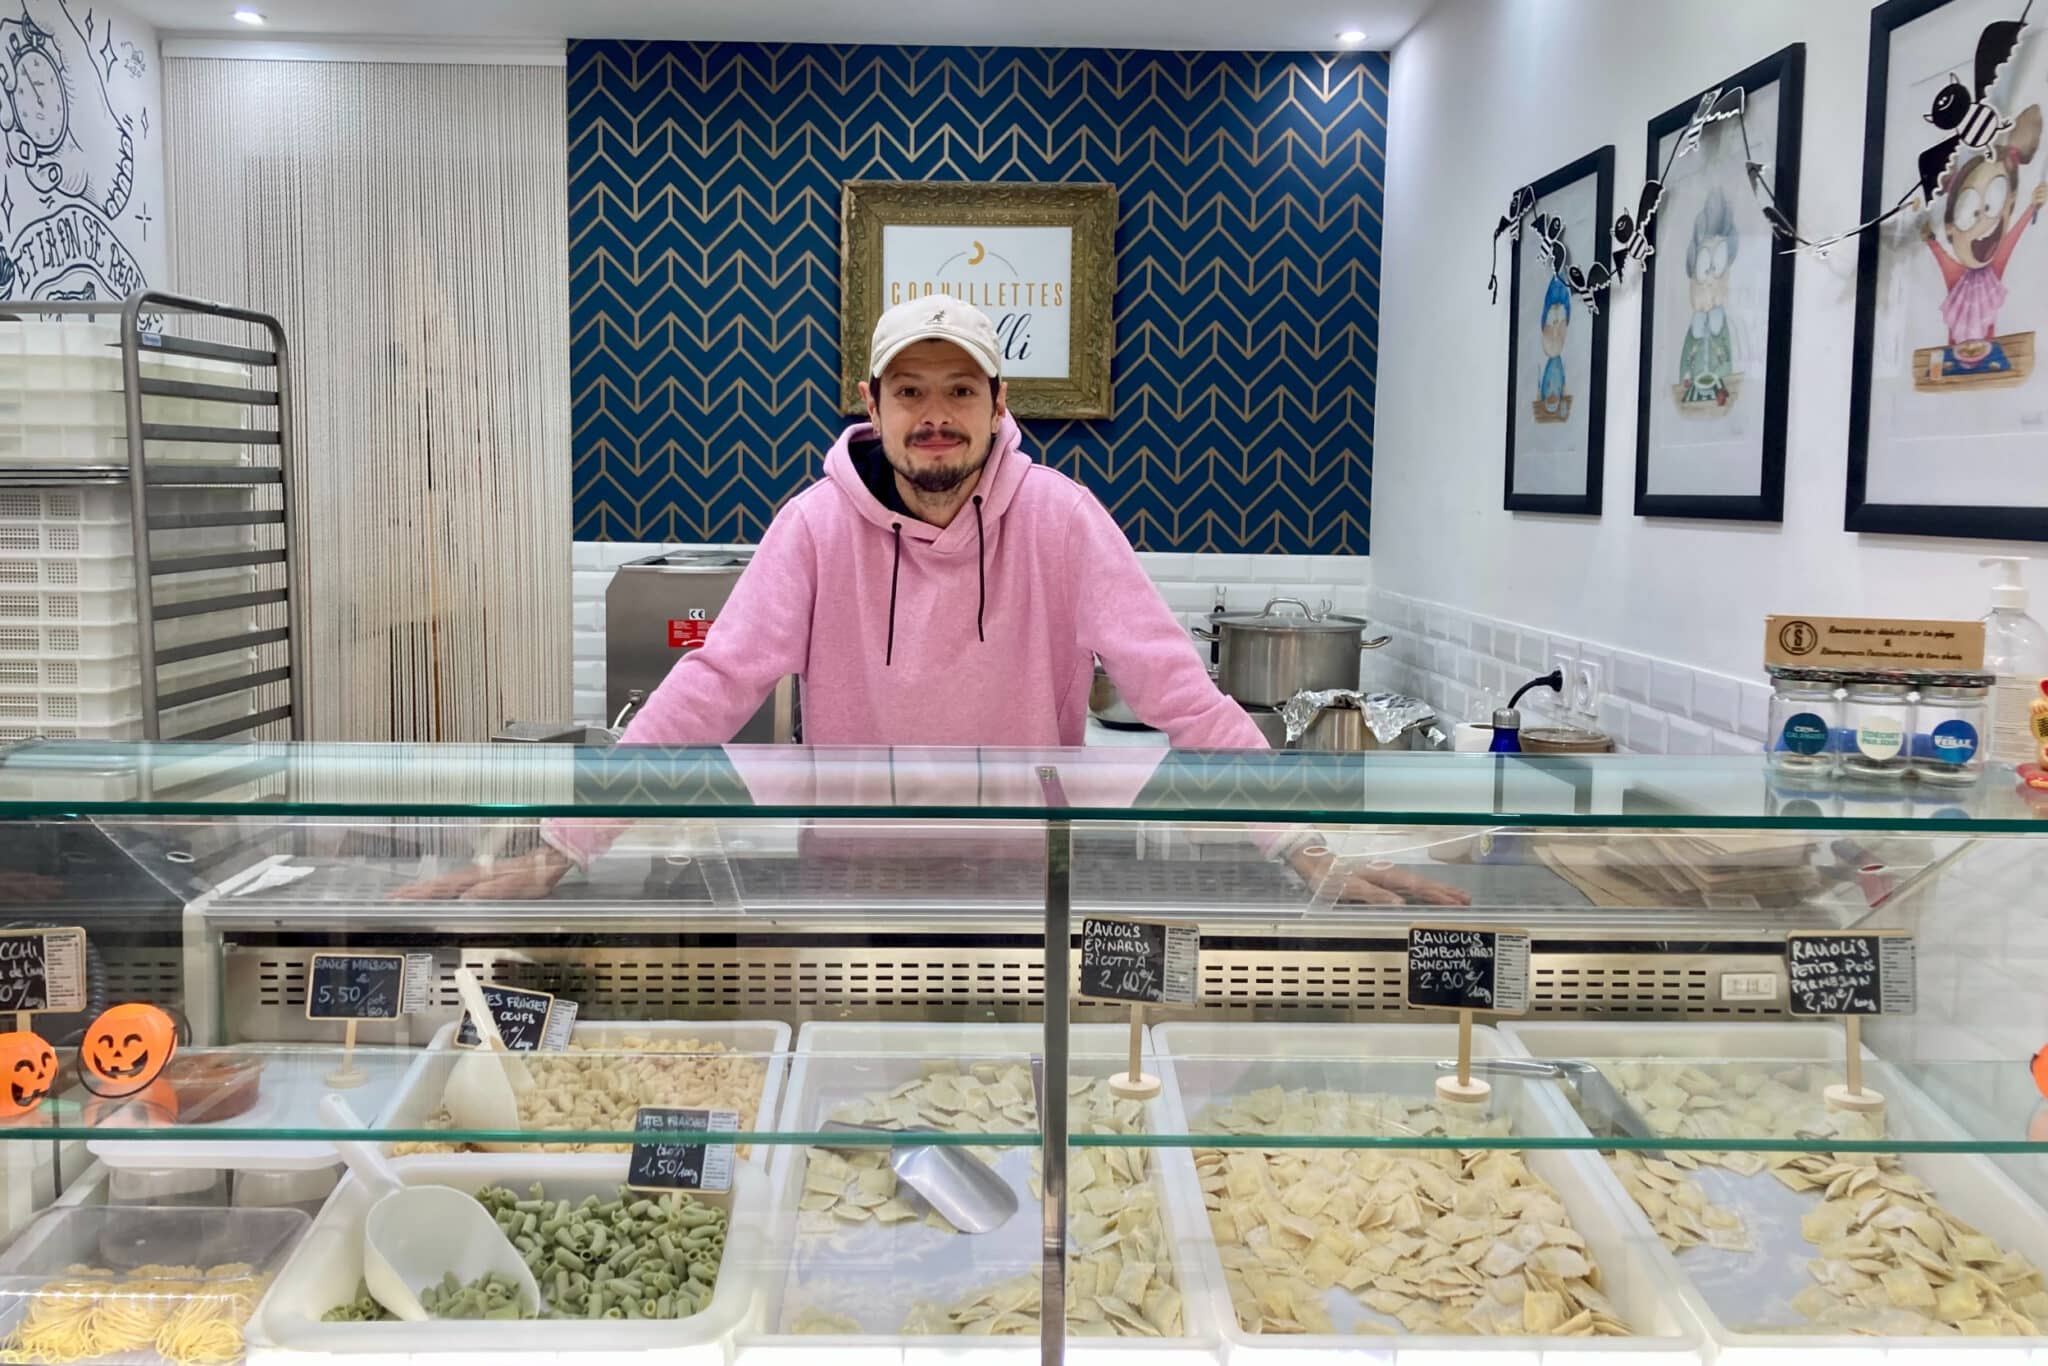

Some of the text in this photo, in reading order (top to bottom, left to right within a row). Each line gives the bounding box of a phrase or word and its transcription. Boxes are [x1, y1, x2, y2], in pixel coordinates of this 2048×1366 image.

[14, 236, 38, 293] ET
[82, 215, 105, 267] SE
[994, 312, 1032, 360] lli
